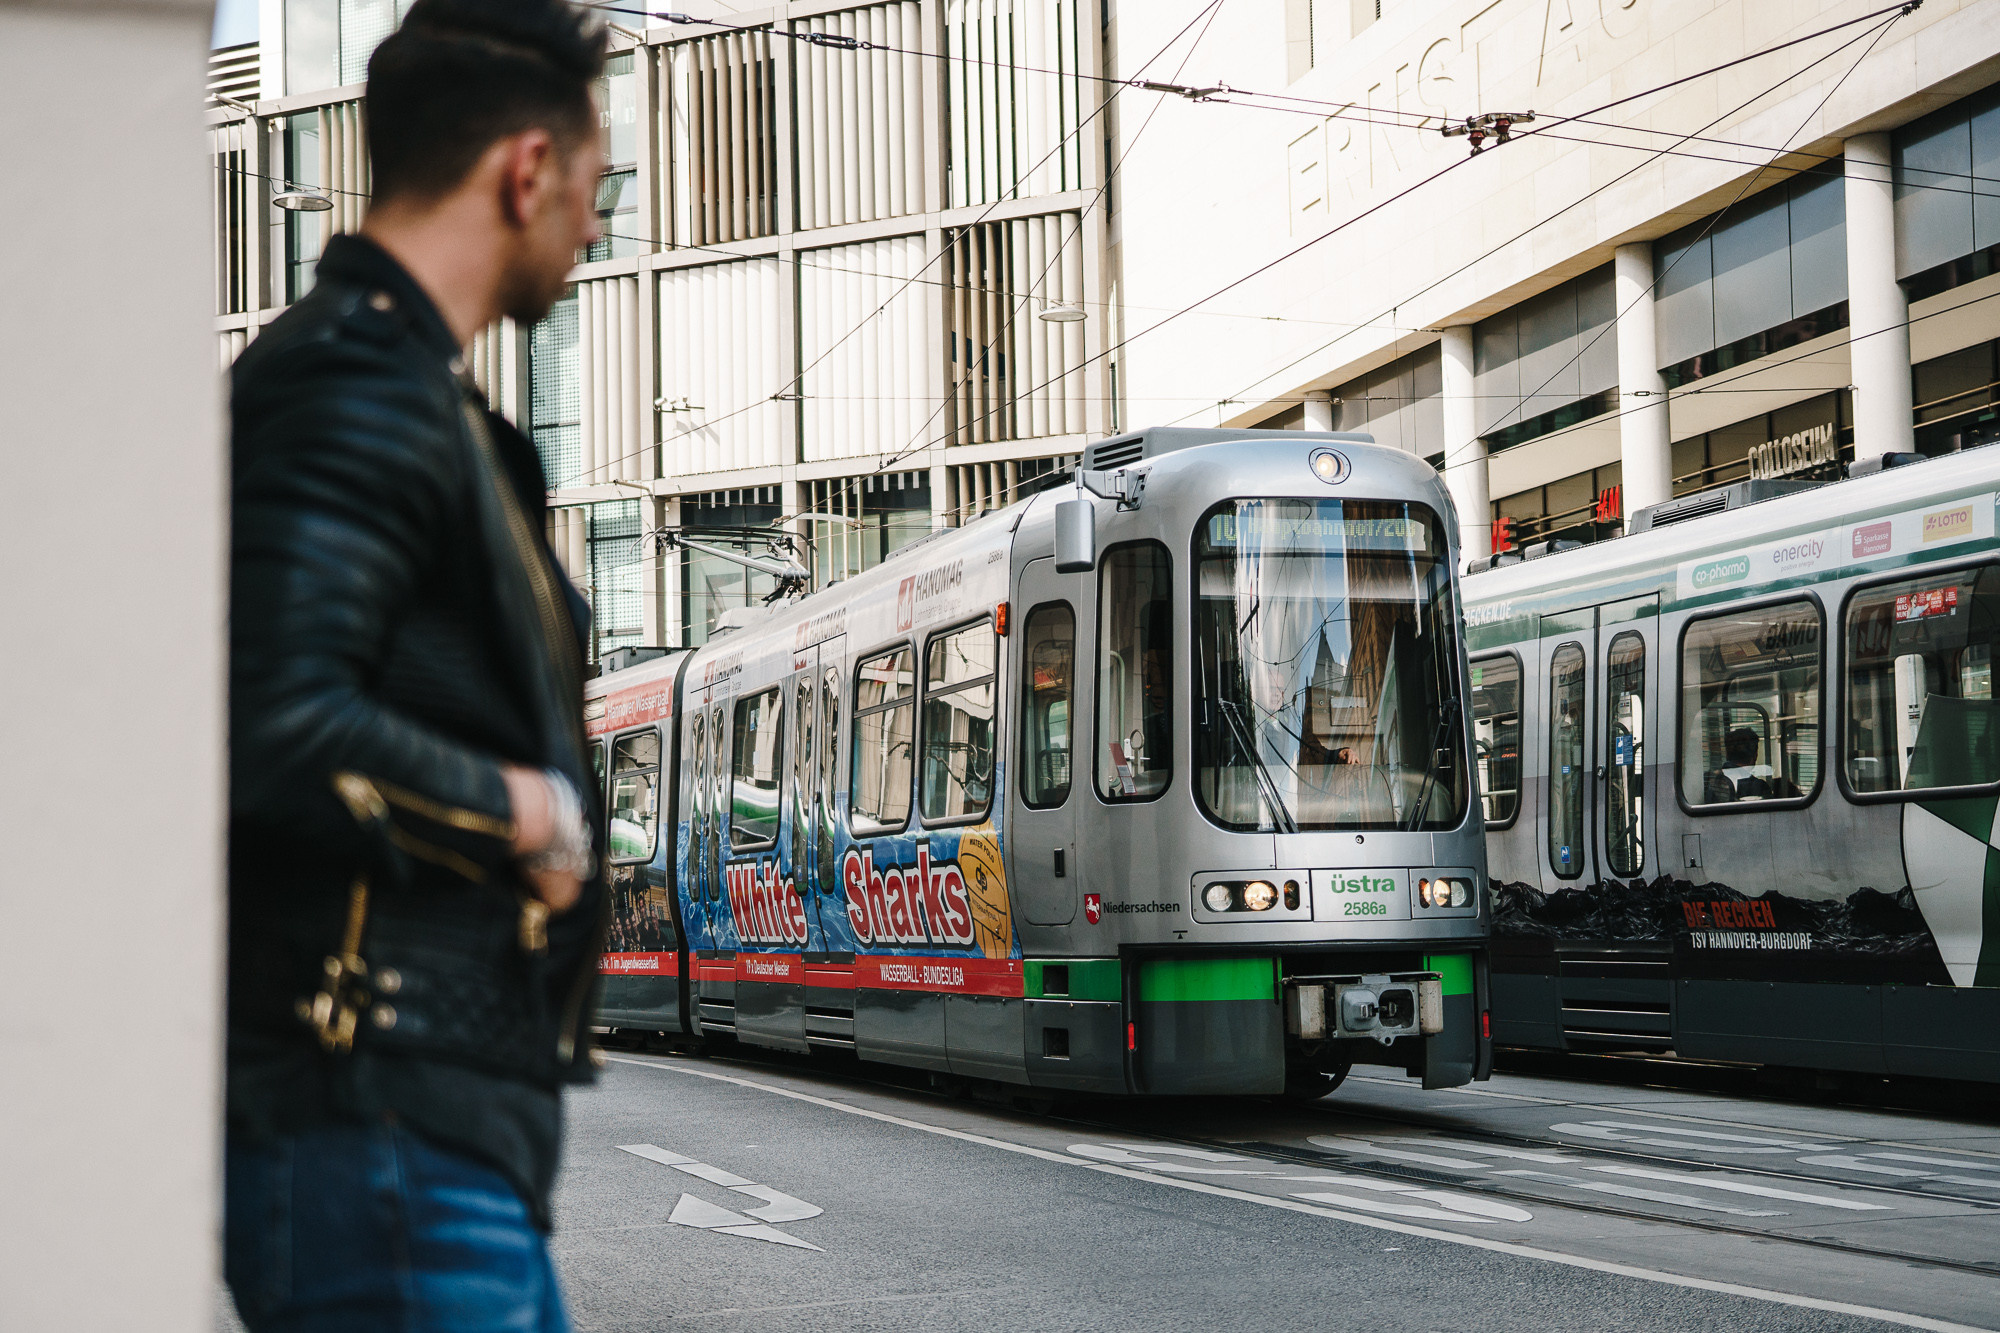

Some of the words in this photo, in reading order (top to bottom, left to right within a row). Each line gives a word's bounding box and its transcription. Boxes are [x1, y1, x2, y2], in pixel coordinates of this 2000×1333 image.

[1748, 422, 1835, 480] COLLOSEUM
[1938, 511, 1967, 528] LOTTO
[1863, 532, 1889, 544] Sparkasse
[1863, 542, 1888, 554] Hannover
[1773, 538, 1824, 564] enercity
[915, 558, 963, 603] HANOMAG
[1696, 561, 1746, 585] cp-pharma
[809, 606, 846, 645] HANOMAG
[607, 701, 635, 720] Hannover
[635, 688, 669, 713] Wasserball
[969, 838, 983, 849] WATER
[983, 844, 994, 863] POLO
[843, 844, 974, 946] Sharks
[1331, 874, 1396, 893] üstra
[726, 855, 809, 945] White
[1103, 900, 1180, 913] Niedersachsen
[1344, 901, 1386, 915] 2586a
[1682, 901, 1711, 928] DIE
[1711, 900, 1776, 928] RECKEN
[1690, 932, 1707, 949] TSV
[1709, 932, 1813, 949] HANNOVER-BURGDORF
[880, 964, 919, 983] WASSERBALL
[923, 966, 965, 985] BUNDESLIGA
